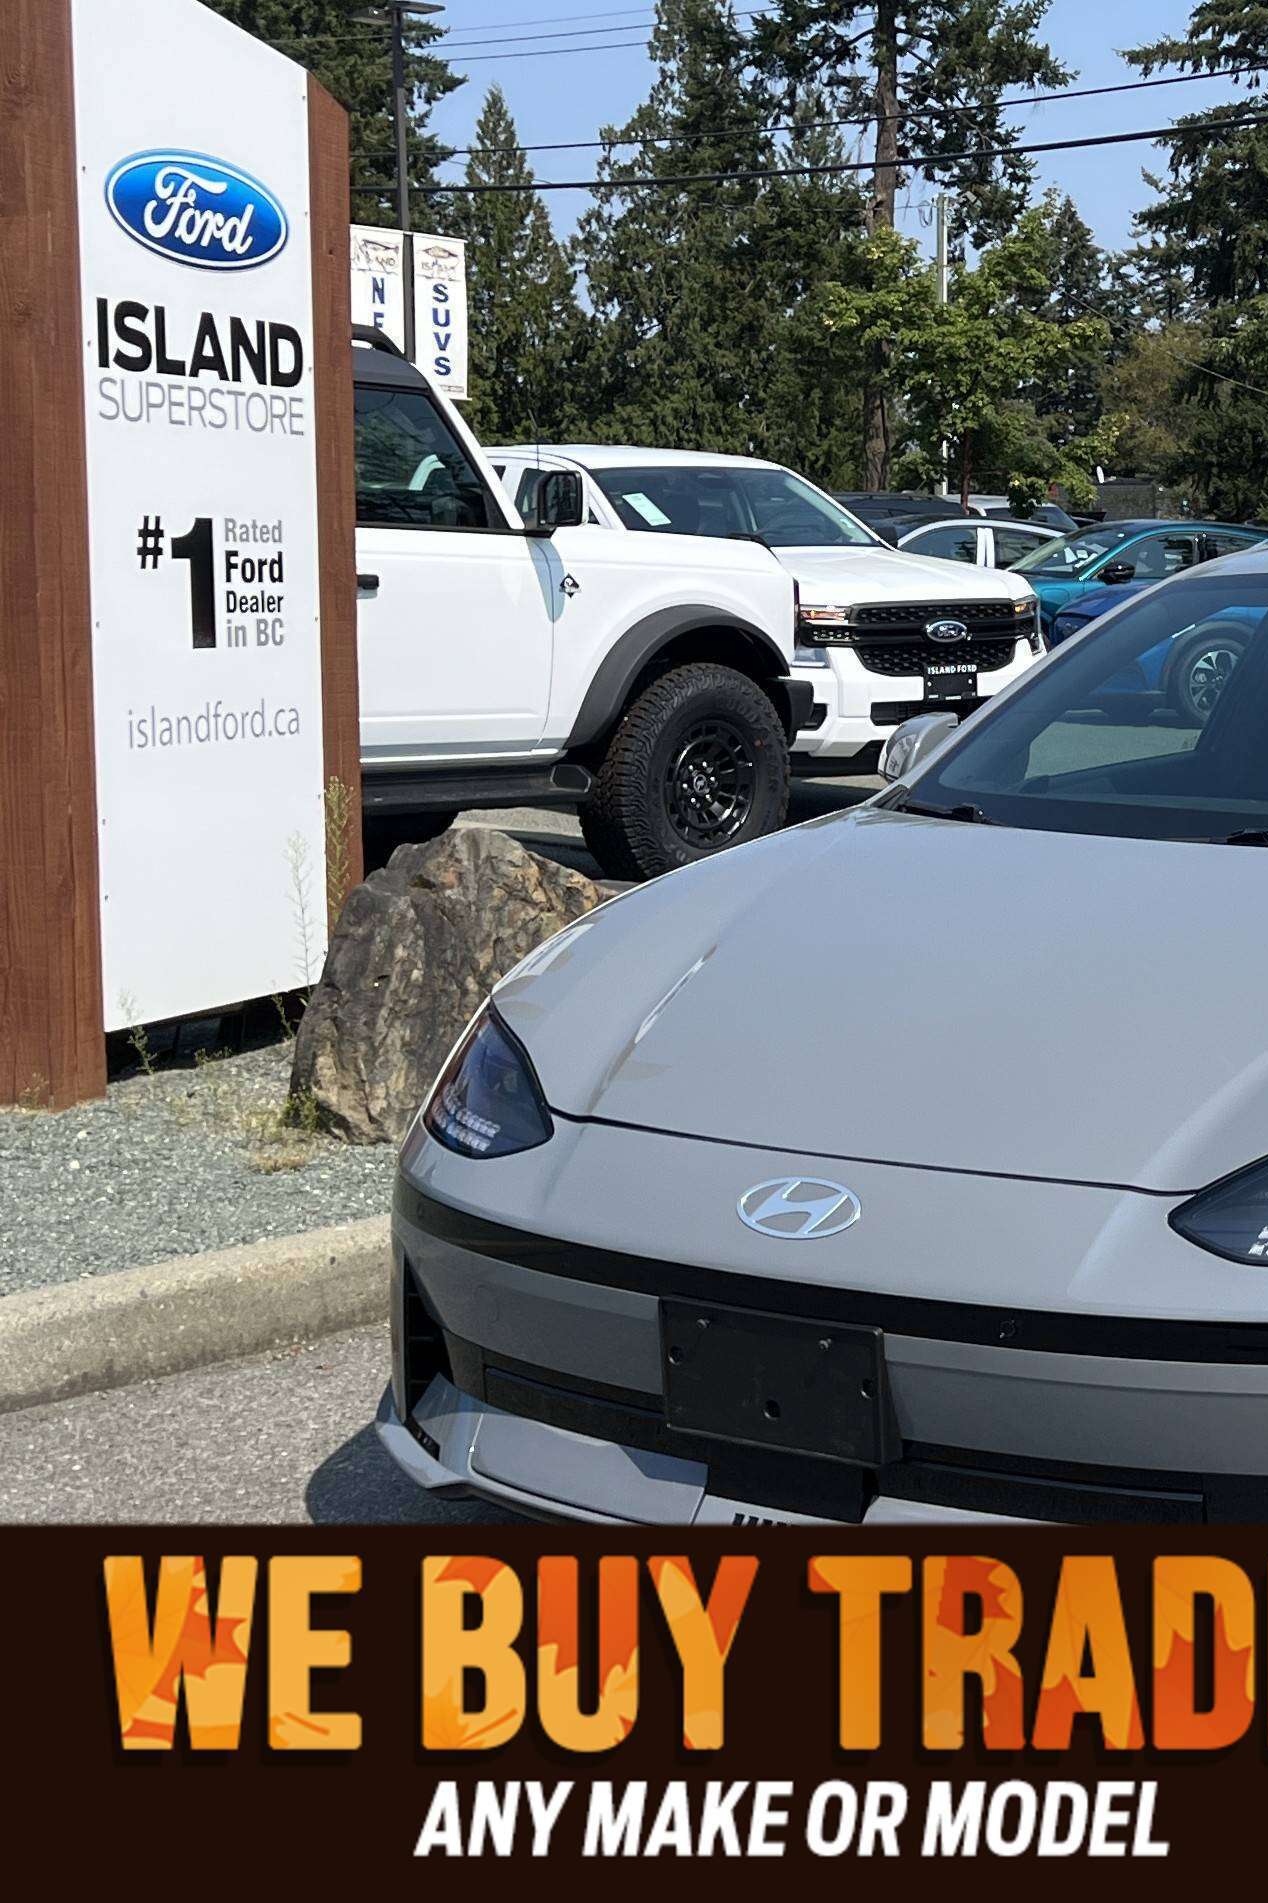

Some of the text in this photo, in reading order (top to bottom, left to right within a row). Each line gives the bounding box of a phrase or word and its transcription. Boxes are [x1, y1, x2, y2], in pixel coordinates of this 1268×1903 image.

[144, 166, 253, 254] Ford
[96, 297, 303, 388] ISLAND
[431, 283, 451, 377] SUVS
[99, 377, 304, 436] SUPERSTORE
[225, 518, 282, 543] Rated
[225, 550, 284, 583] Ford
[226, 590, 284, 613] Dealer
[227, 618, 284, 647] in BC
[128, 698, 300, 750] islandford.ca
